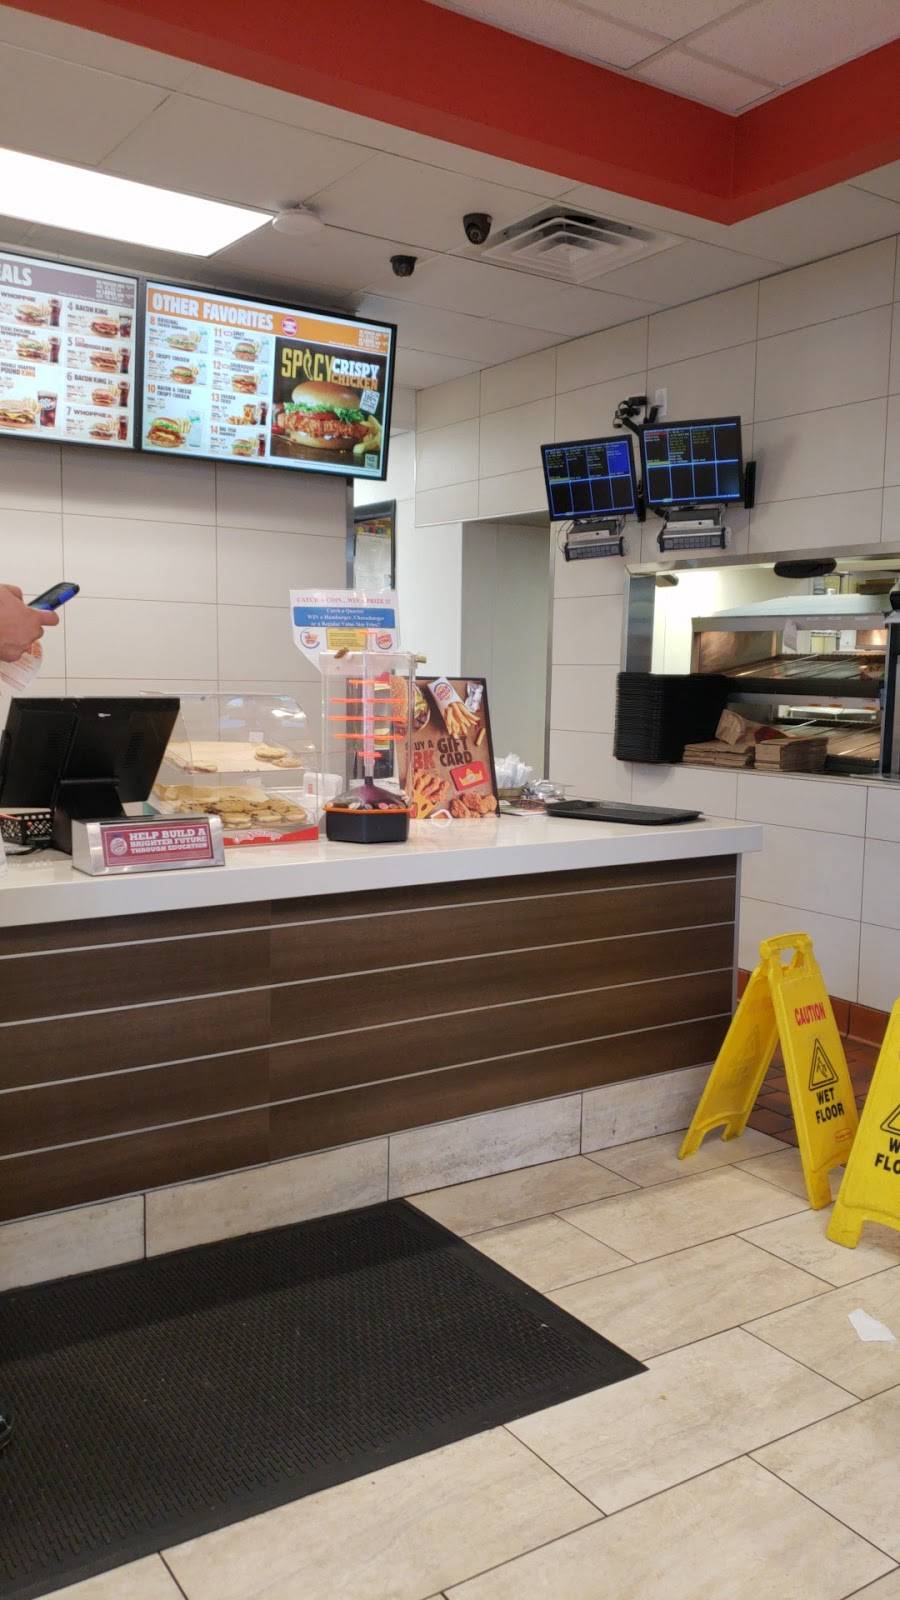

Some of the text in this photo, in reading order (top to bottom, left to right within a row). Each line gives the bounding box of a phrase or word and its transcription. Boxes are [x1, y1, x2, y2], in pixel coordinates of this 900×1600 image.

[152, 293, 199, 320] OTHER
[202, 302, 273, 330] FAVORITES
[332, 358, 380, 381] CRISPY
[331, 374, 378, 390] CHICKEN
[428, 740, 434, 748] A
[436, 736, 469, 754] GIFT
[440, 751, 473, 768] CARD
[128, 828, 206, 840] HELP BUILD A
[130, 836, 208, 848] BRIGHTER FUTURE
[132, 842, 208, 854] THROUGH EDUCATION
[794, 1002, 826, 1026] CAUTION
[816, 1088, 836, 1106] WET
[816, 1102, 844, 1124] FLOOR
